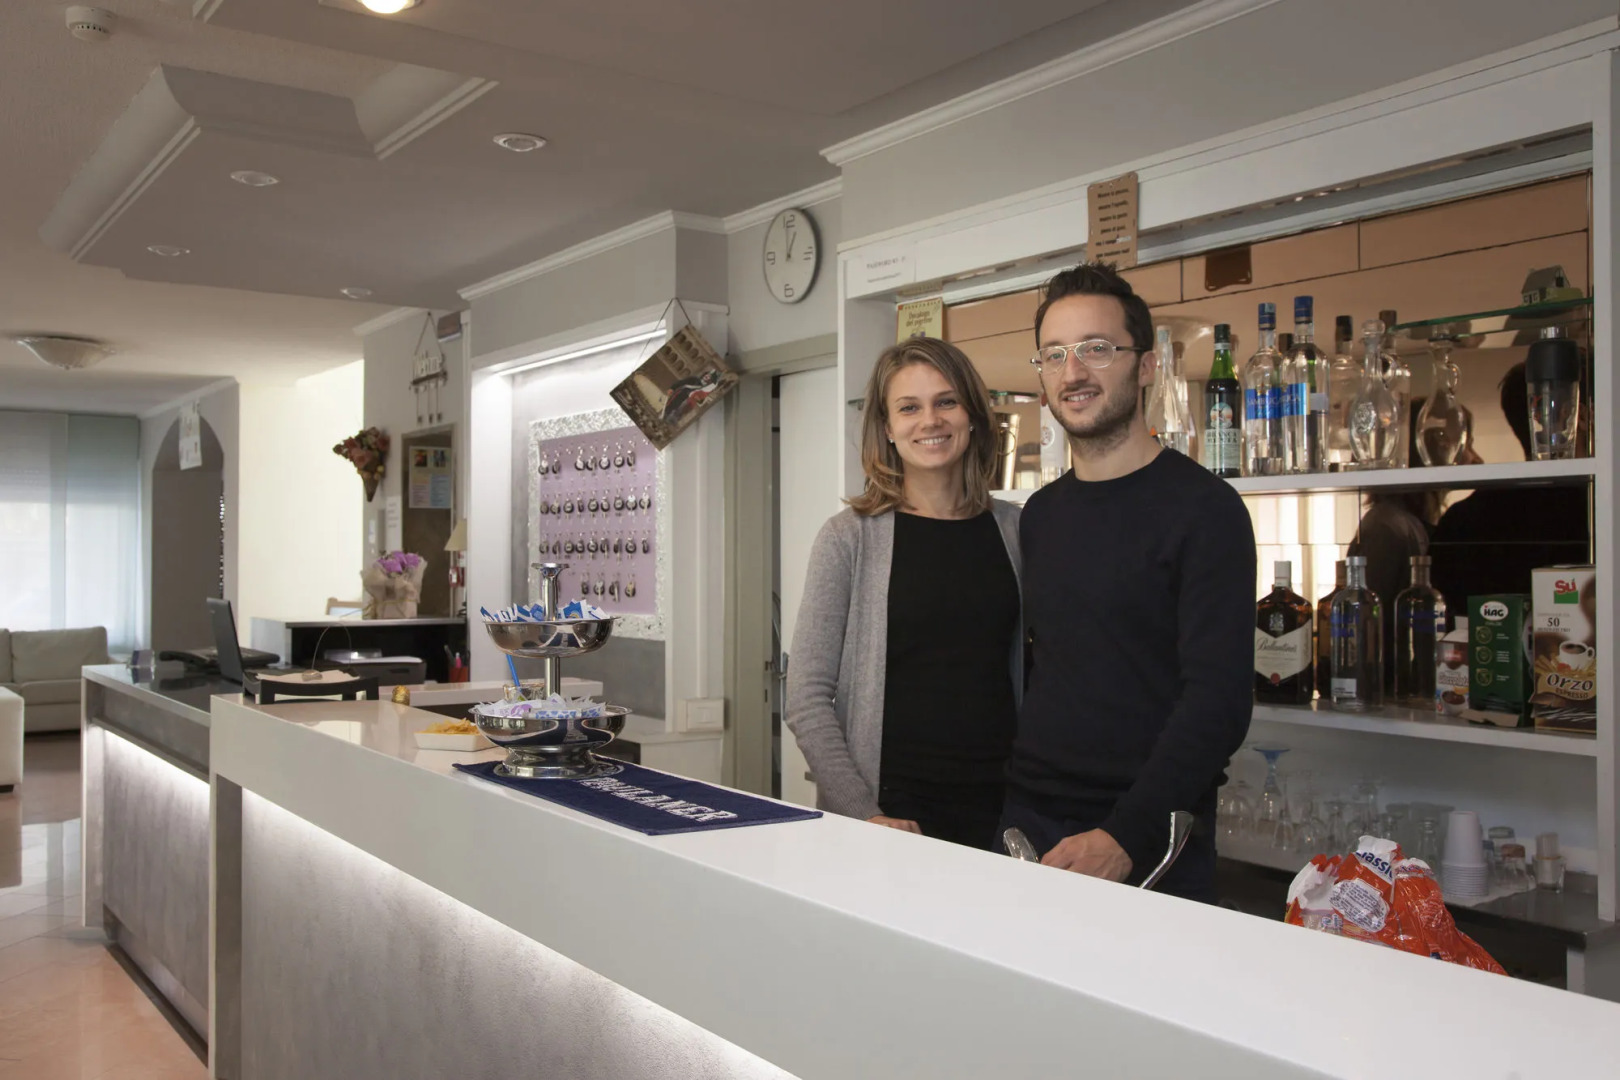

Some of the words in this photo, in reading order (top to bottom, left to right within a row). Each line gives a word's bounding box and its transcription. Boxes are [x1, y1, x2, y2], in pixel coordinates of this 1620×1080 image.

[782, 214, 796, 229] 12
[766, 251, 776, 265] 9
[803, 246, 814, 261] 3
[784, 283, 795, 298] 6
[1484, 608, 1504, 617] HAG
[1547, 617, 1560, 627] 50
[1547, 673, 1593, 691] Orzo
[1555, 688, 1589, 699] ESPRESSO
